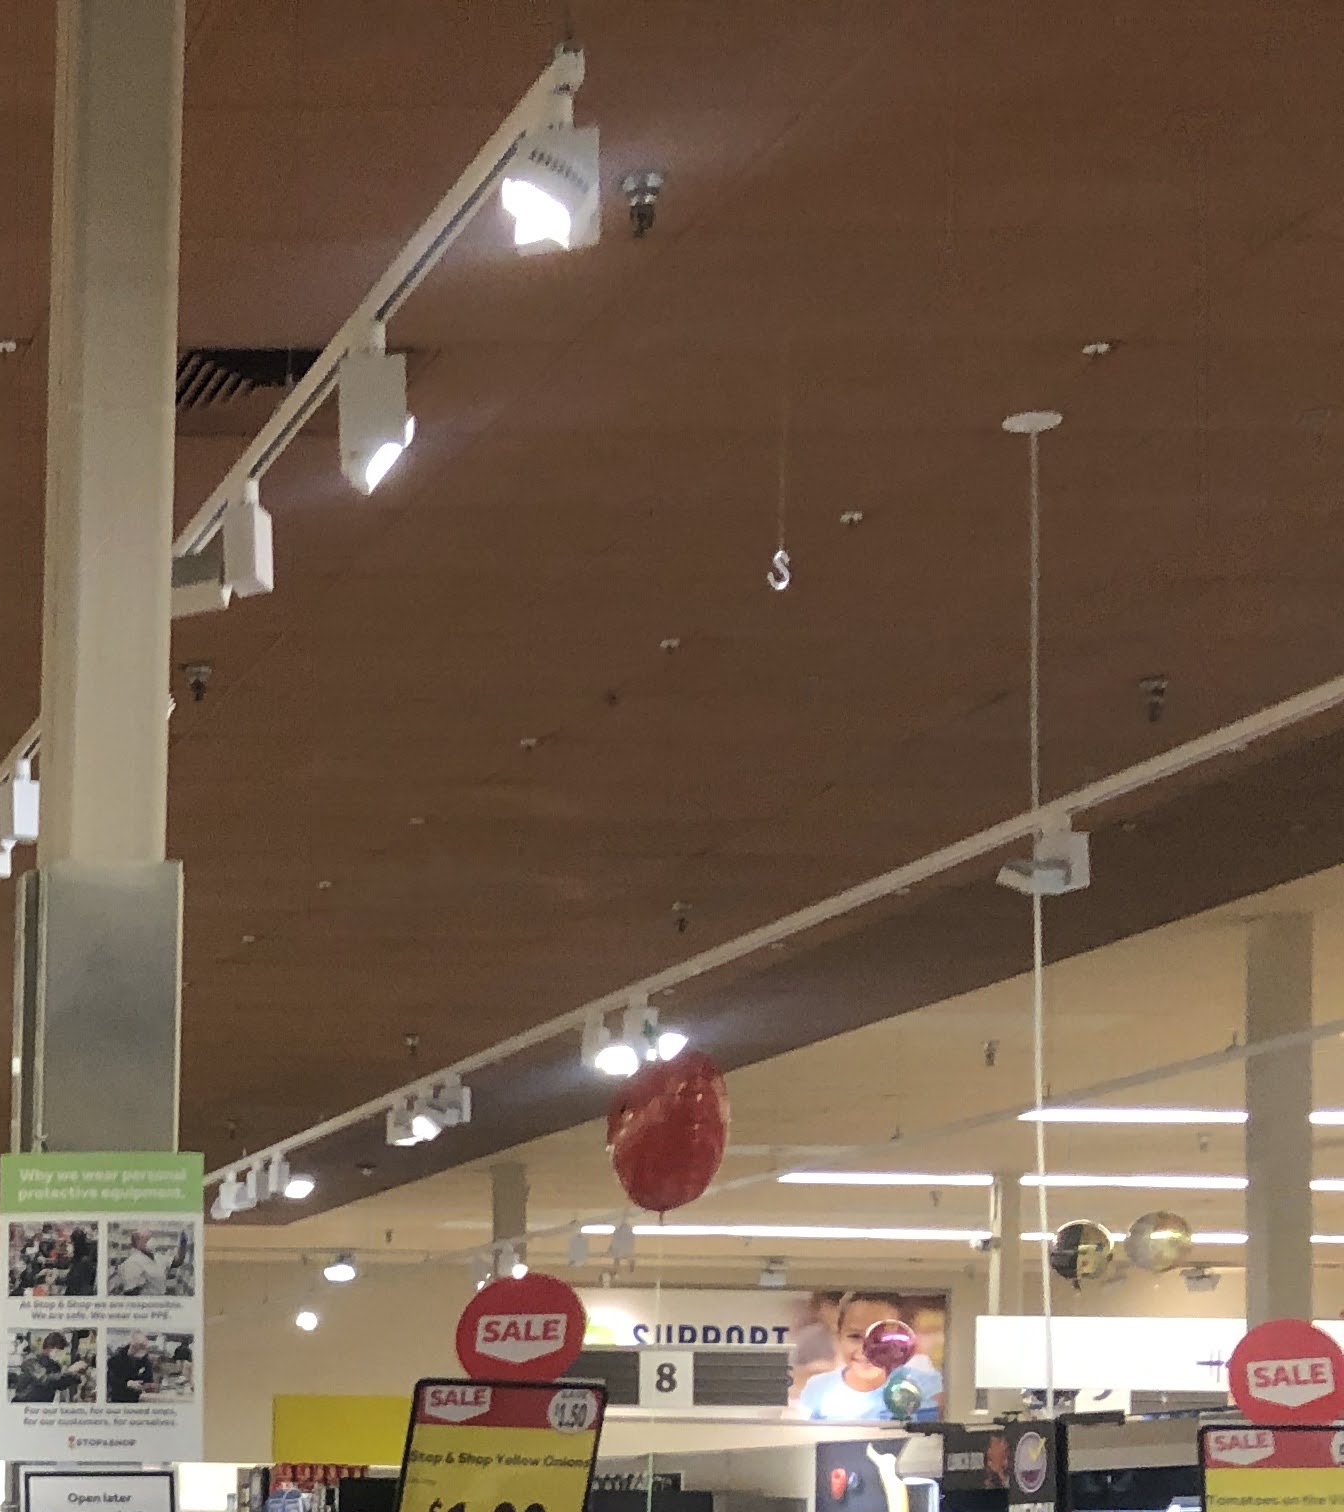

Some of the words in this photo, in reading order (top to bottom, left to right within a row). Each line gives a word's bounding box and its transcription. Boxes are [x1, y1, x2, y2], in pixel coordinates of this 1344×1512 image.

[19, 1168, 53, 1183] Why
[82, 1170, 118, 1182] wear
[122, 1168, 187, 1184] personal
[17, 1187, 98, 1202] protective
[482, 1318, 561, 1343] SALE
[655, 1361, 677, 1393] 8
[1253, 1361, 1328, 1387] SALE
[429, 1387, 488, 1407] SALE
[1213, 1433, 1272, 1452] SALE
[411, 1450, 442, 1466] Stop
[444, 1451, 454, 1465] &
[458, 1452, 494, 1467] Shop
[496, 1453, 540, 1467] Yellow
[542, 1454, 592, 1469] Onions
[67, 1492, 101, 1505] Open
[103, 1492, 132, 1502] later
